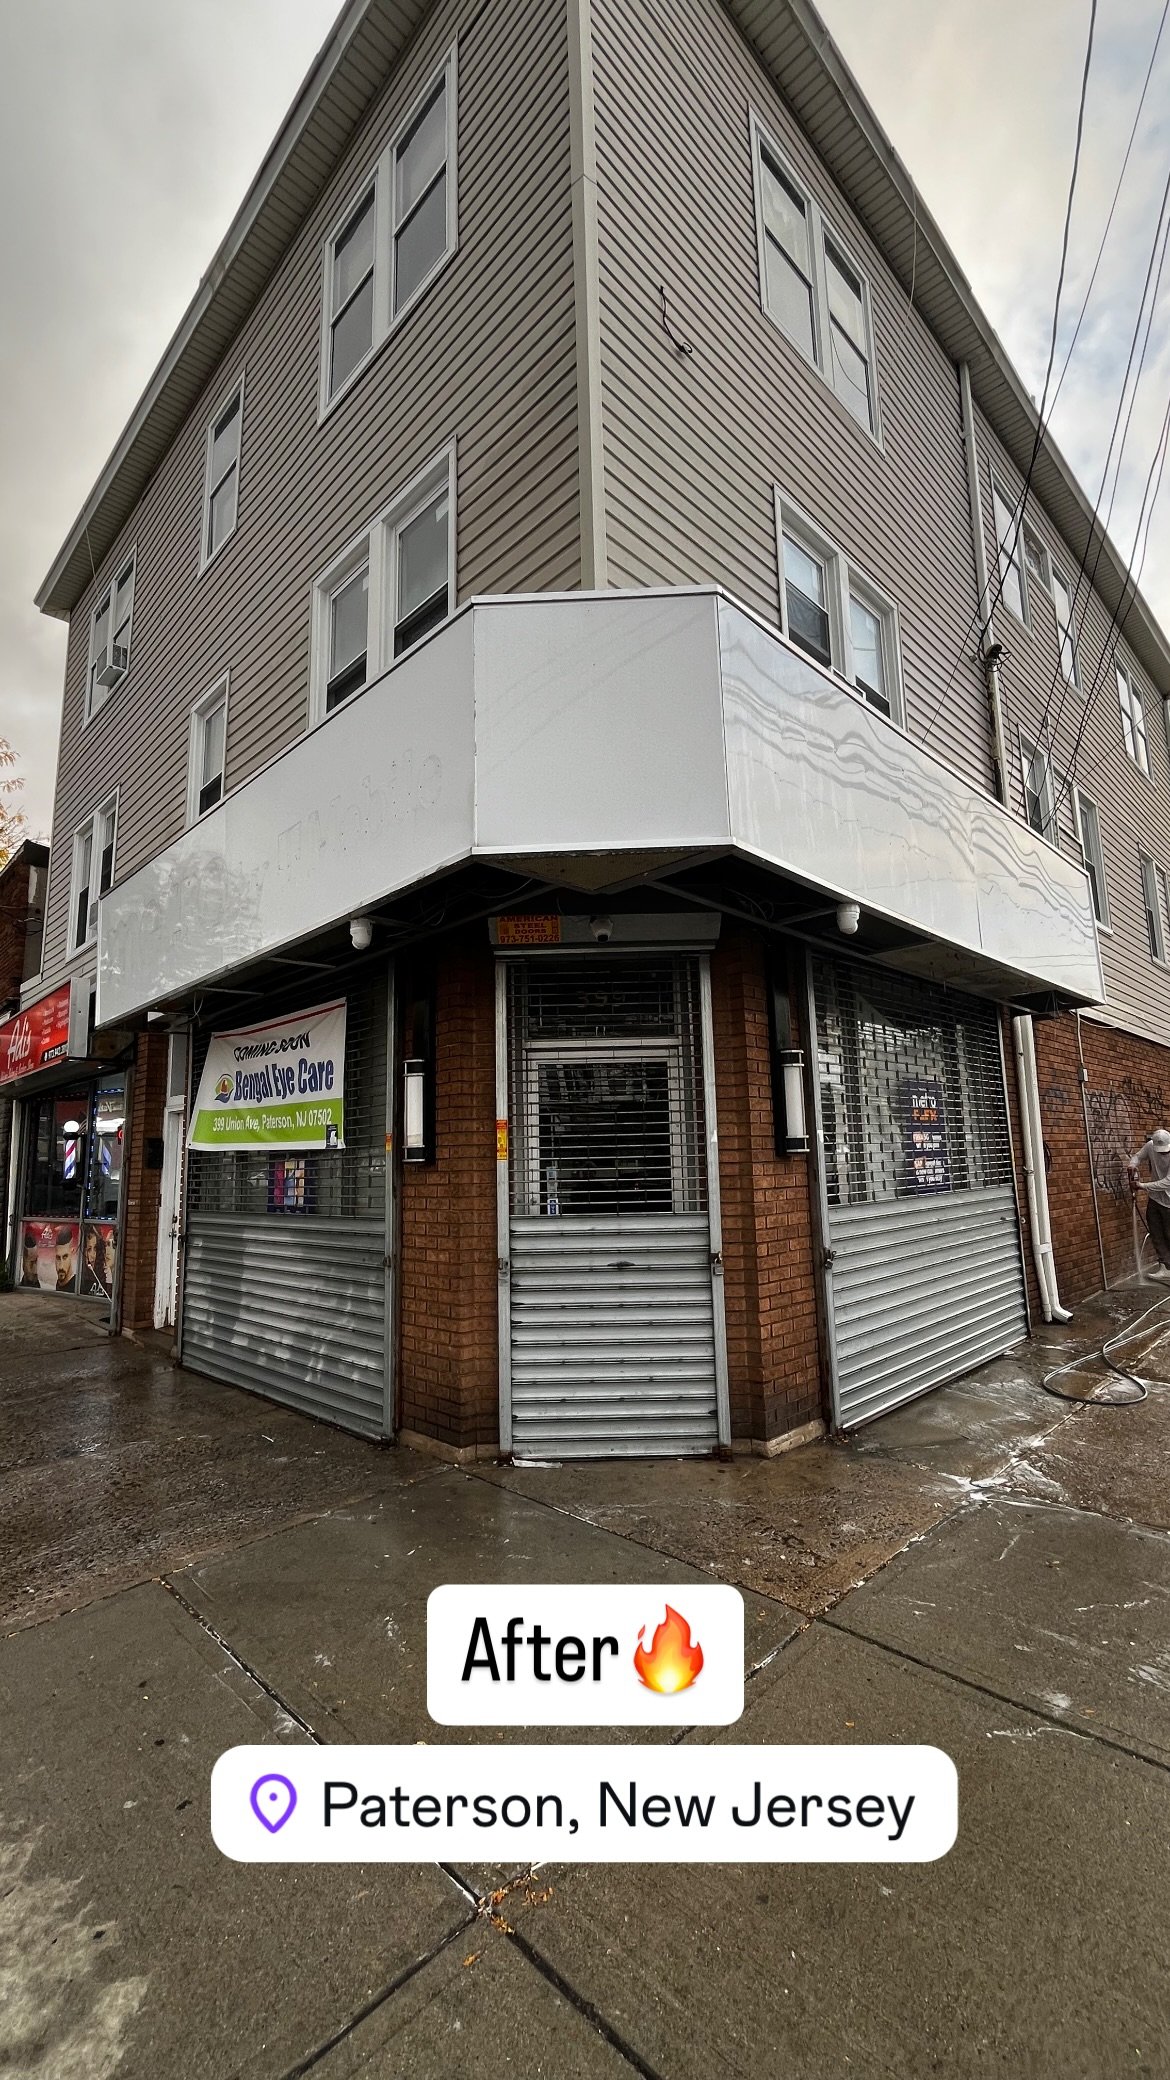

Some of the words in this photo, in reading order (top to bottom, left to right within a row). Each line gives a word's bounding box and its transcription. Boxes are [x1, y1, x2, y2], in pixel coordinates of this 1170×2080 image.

[499, 914, 558, 922] AMERICAN
[499, 934, 560, 944] 973-751-0226
[233, 1040, 278, 1063] COMING
[275, 1030, 311, 1054] SOON
[233, 1064, 274, 1104] Bengal
[271, 1063, 296, 1100] Eye
[297, 1057, 335, 1095] Care
[212, 1117, 226, 1132] 399
[225, 1115, 245, 1131] Union
[245, 1115, 260, 1133] Ave,
[261, 1114, 295, 1130] Paterson,
[295, 1111, 307, 1128] NJ
[308, 1107, 333, 1126] 07502
